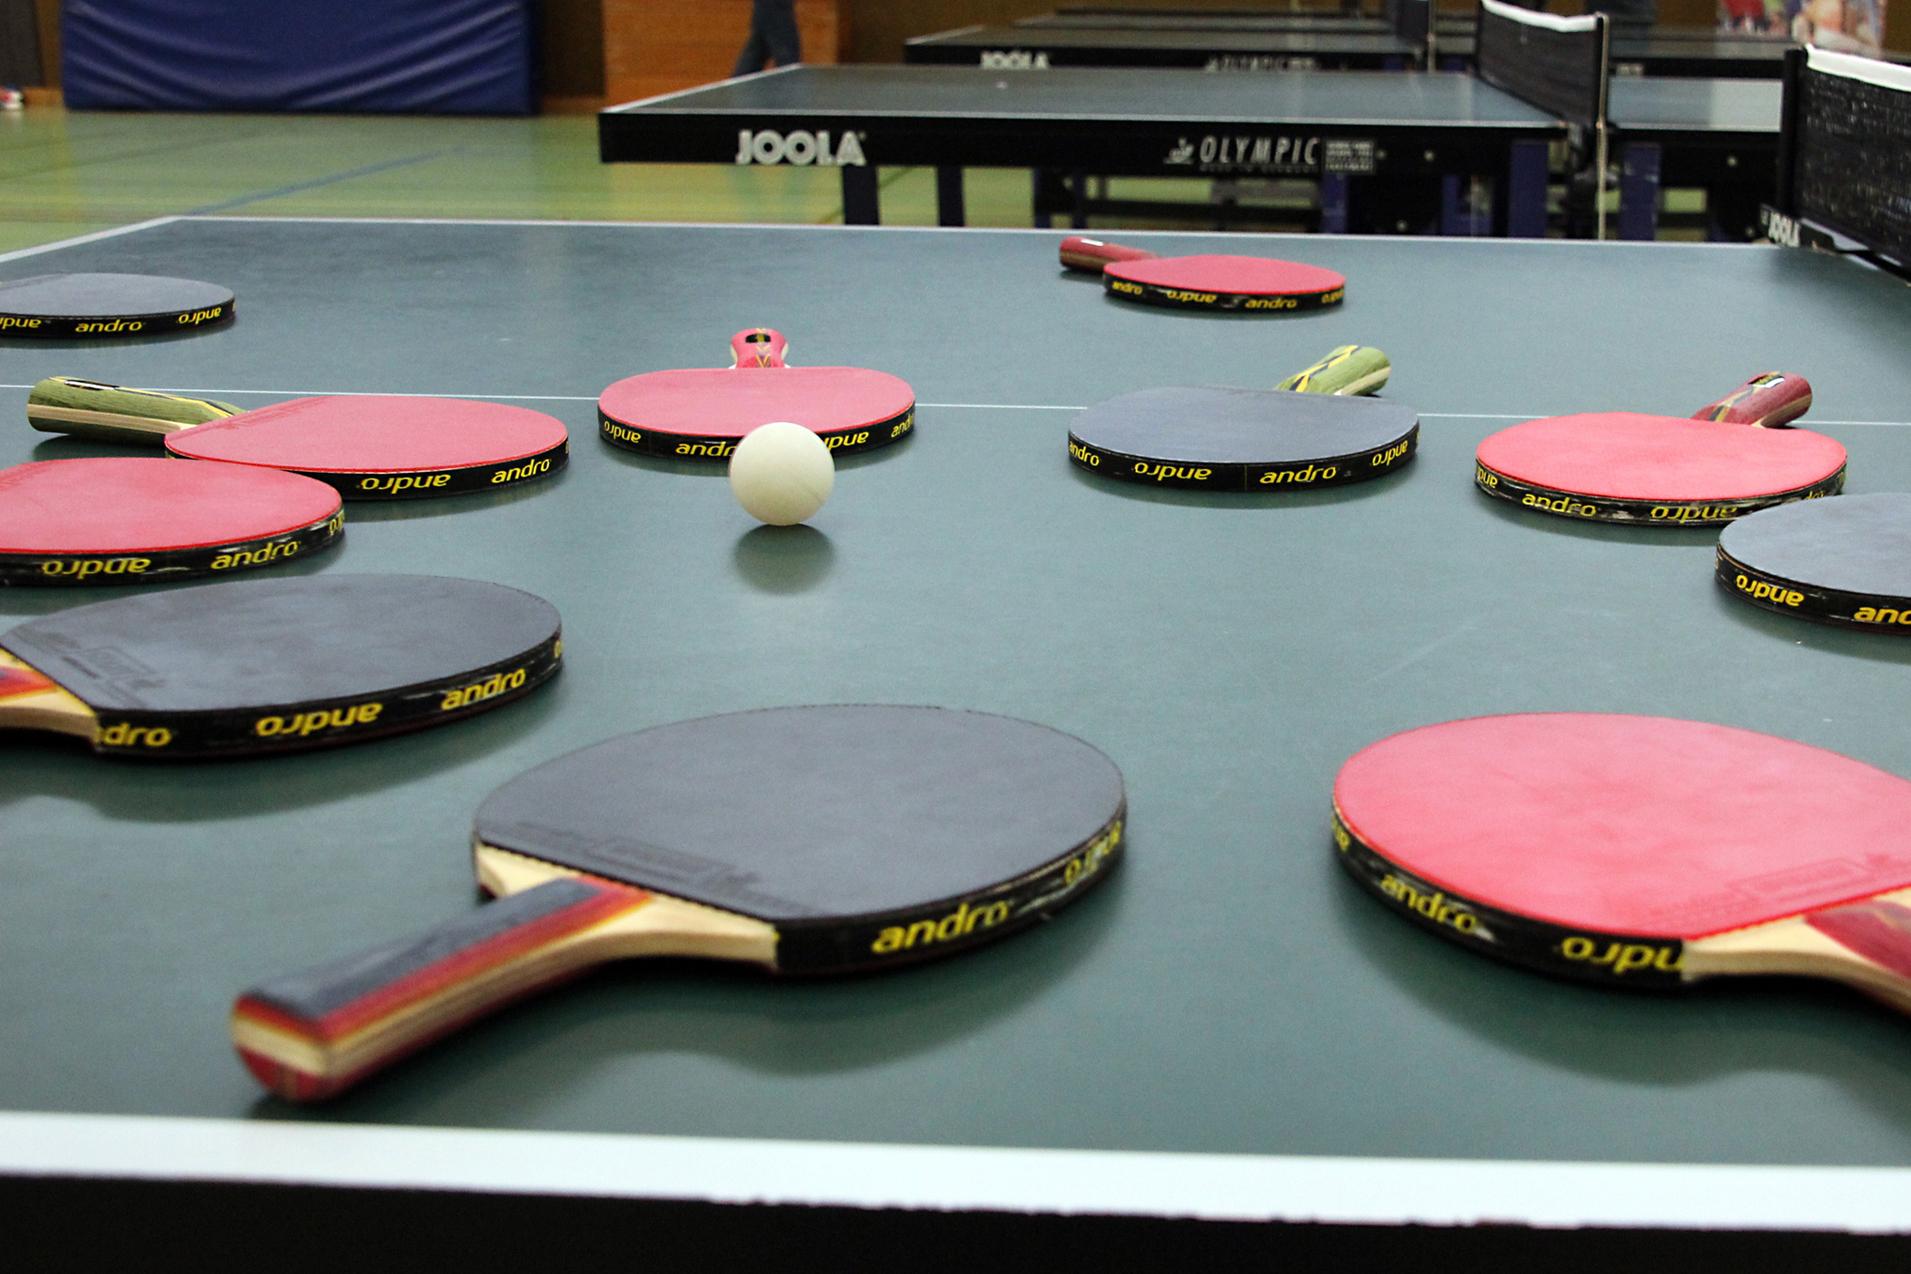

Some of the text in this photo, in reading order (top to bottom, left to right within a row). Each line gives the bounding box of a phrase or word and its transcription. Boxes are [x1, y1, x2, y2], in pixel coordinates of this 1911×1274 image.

[735, 129, 866, 167] JOOLA
[1199, 136, 1320, 165] OLYMPIC
[1166, 290, 1217, 304] andro
[1244, 298, 1297, 309] andro
[0, 317, 42, 330] and
[74, 319, 143, 333] andro
[177, 307, 222, 325] andro
[604, 421, 642, 444] andro
[824, 431, 870, 450] and
[674, 440, 736, 457] andr
[1069, 441, 1101, 467] andro
[1371, 439, 1409, 467] andro
[490, 458, 552, 484] andro
[1134, 461, 1213, 481] andro
[1258, 463, 1337, 485] andro
[360, 473, 452, 495] andro
[1520, 491, 1597, 518] andro
[1649, 503, 1738, 524] andro
[209, 539, 301, 571] andro
[41, 557, 152, 580] andro
[1735, 573, 1806, 608] andro
[440, 667, 527, 711] andro
[255, 702, 384, 737] andro
[97, 722, 172, 747] dro
[1378, 872, 1480, 936] andro
[871, 900, 1010, 954] andro
[1562, 936, 1686, 974] ndro
